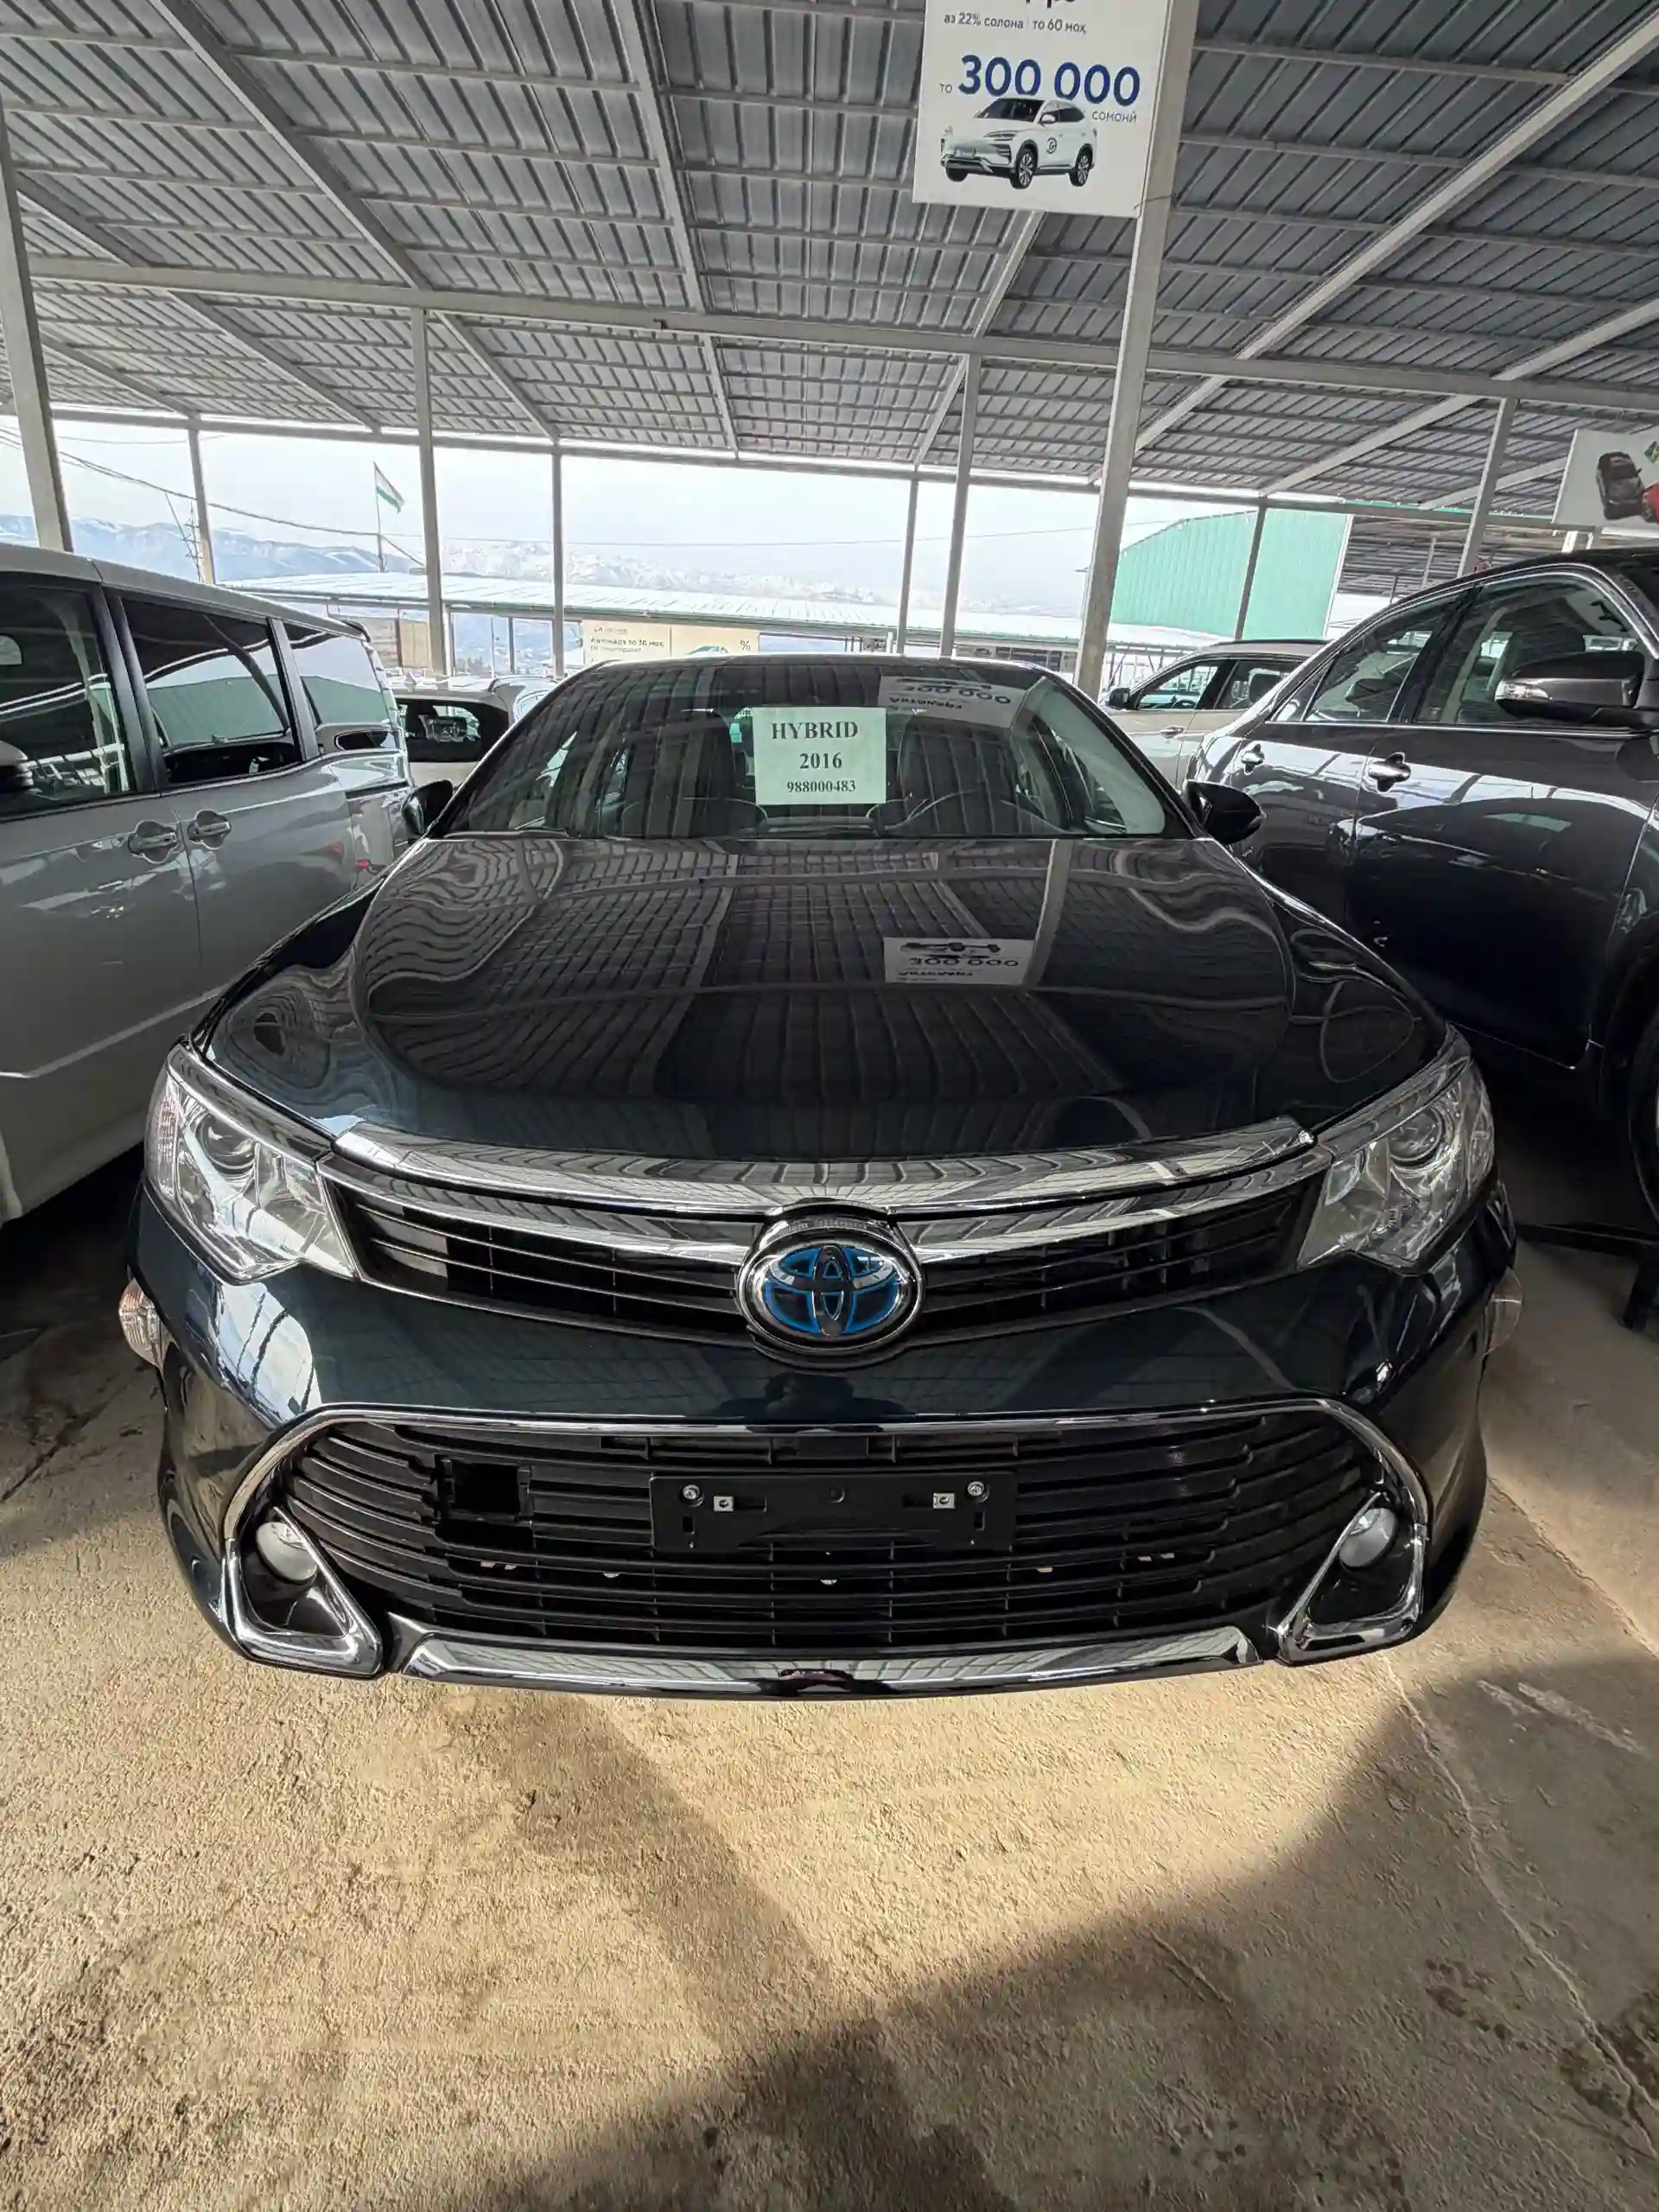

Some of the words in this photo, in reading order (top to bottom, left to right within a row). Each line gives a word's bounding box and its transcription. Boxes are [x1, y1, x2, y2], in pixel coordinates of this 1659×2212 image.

[944, 14, 956, 23] аз
[958, 12, 982, 26] 22%
[984, 17, 1024, 29] солона
[1033, 20, 1045, 29] то
[1047, 19, 1063, 31] 60
[939, 83, 953, 93] то
[957, 54, 1041, 97] 300
[1053, 61, 1141, 107] 000
[772, 721, 858, 740] HYBRID
[799, 753, 842, 769] 2016
[787, 780, 856, 793] 988000483
